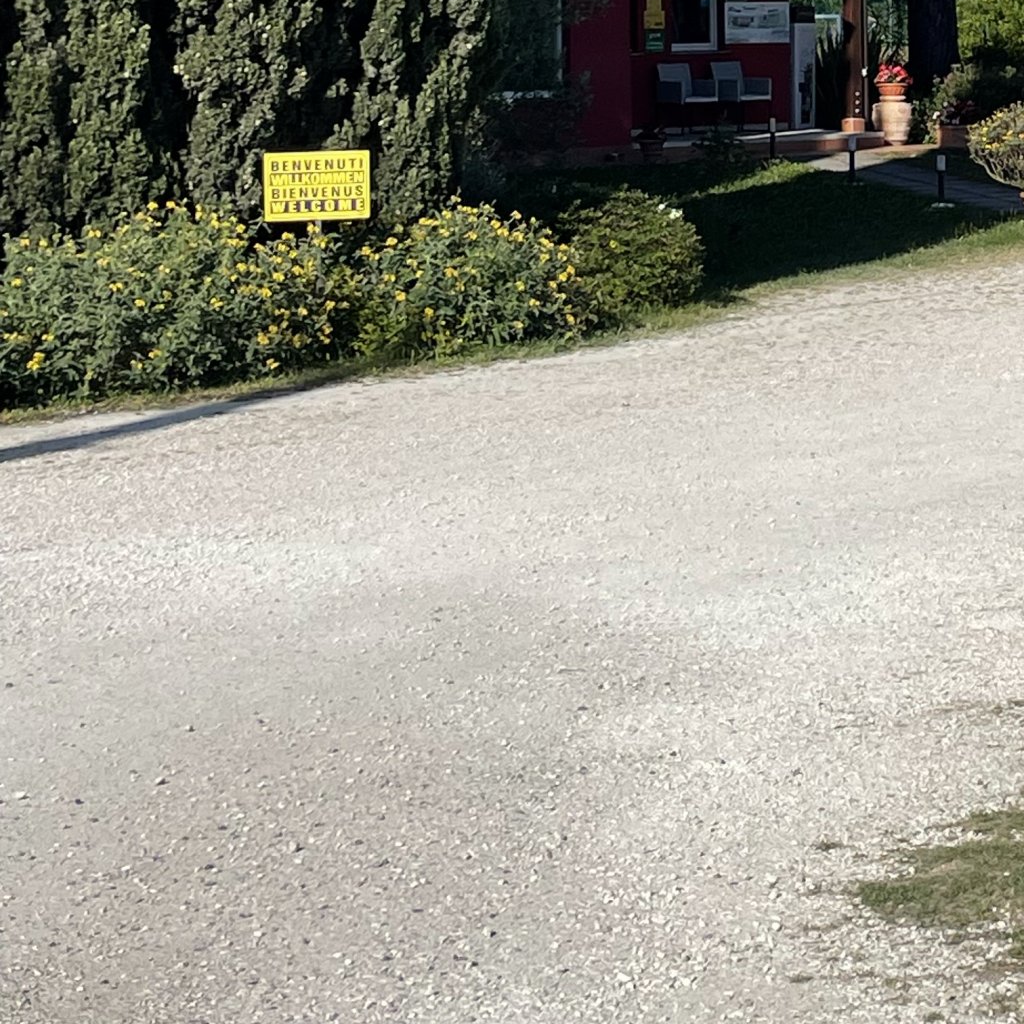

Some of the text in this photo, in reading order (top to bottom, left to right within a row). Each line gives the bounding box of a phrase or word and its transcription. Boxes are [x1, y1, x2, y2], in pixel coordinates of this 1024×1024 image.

[271, 158, 363, 172] BENVENUTI
[270, 171, 364, 186] WILLKOMMEN
[272, 185, 363, 199] BIENVENUS
[271, 198, 365, 214] WELCOME
